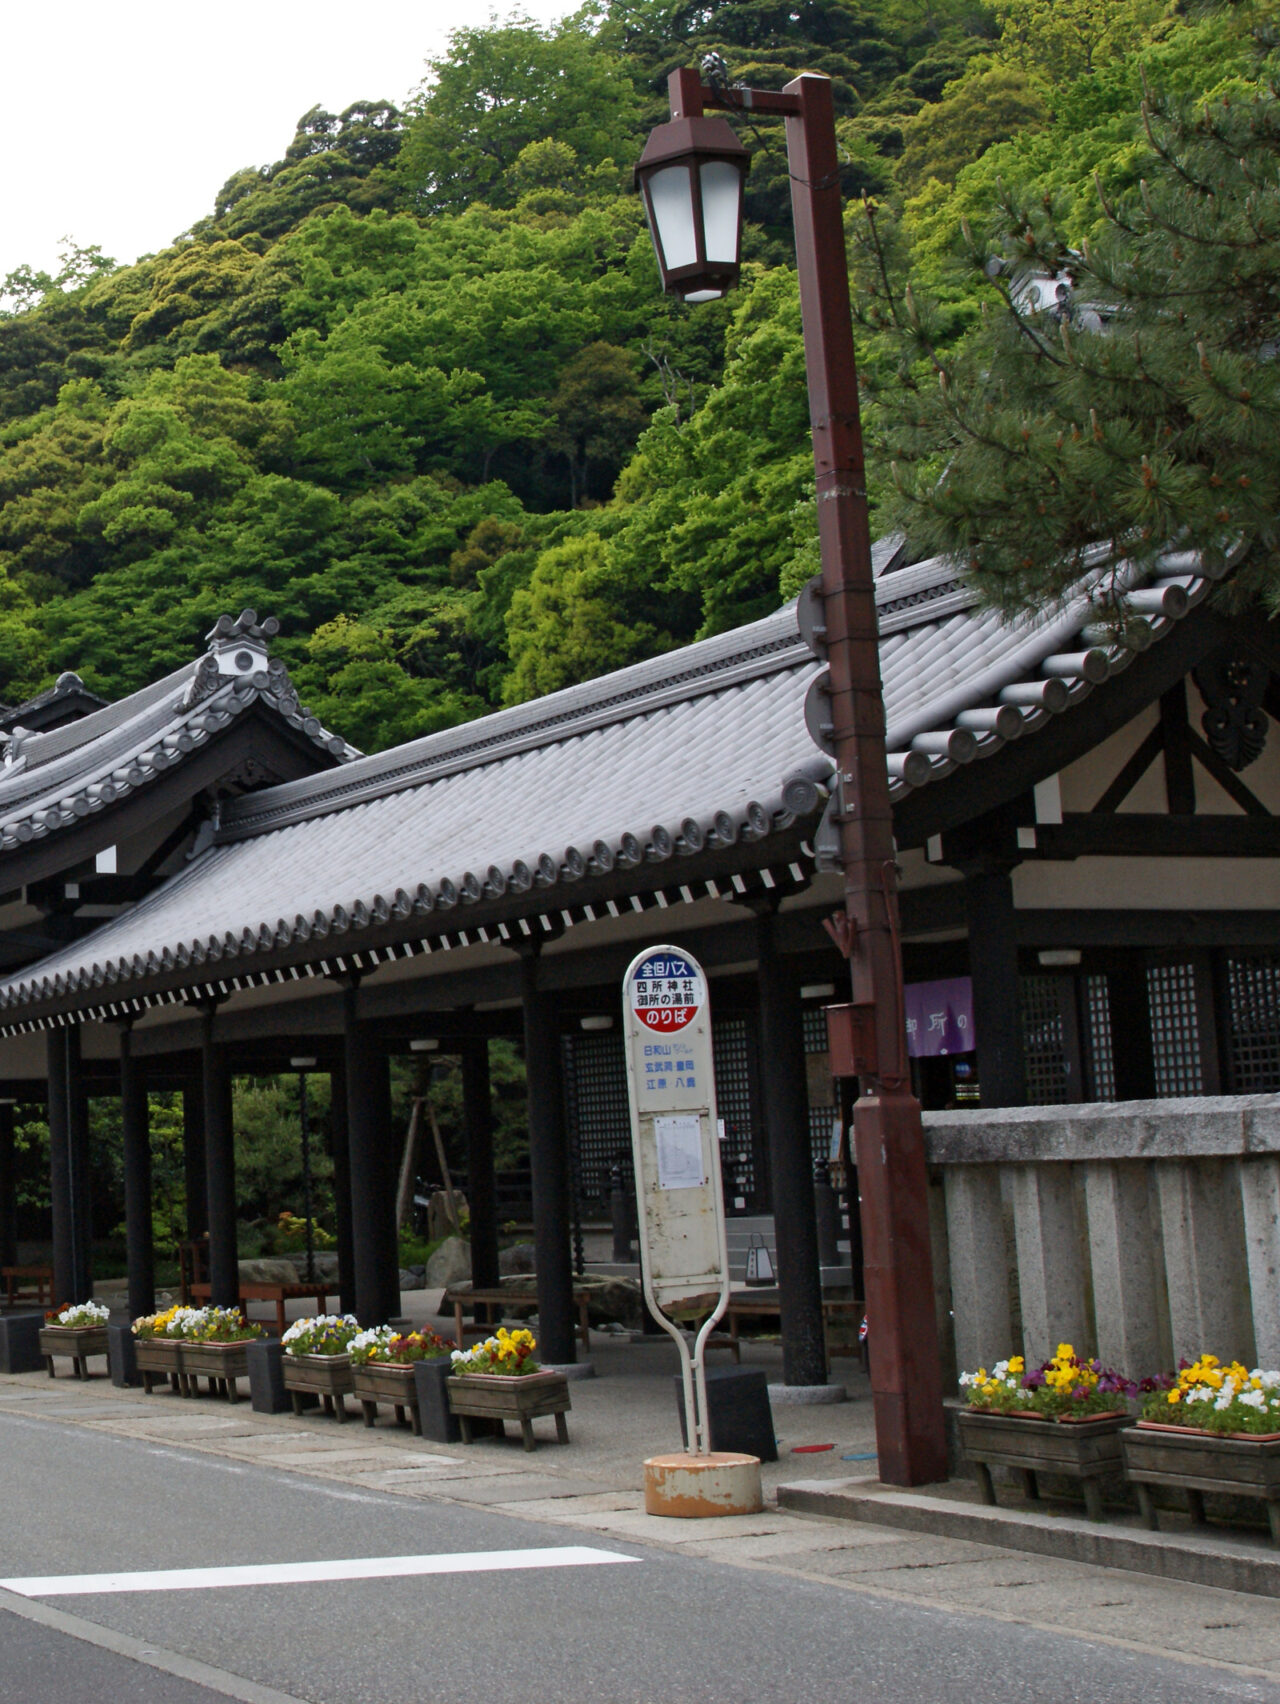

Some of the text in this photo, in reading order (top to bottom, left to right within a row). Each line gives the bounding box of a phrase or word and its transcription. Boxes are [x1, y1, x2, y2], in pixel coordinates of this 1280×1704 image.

[641, 961, 688, 977] 全但バス
[637, 979, 694, 993] 四所神社
[637, 992, 695, 1007] 御所の湯前
[646, 1008, 688, 1025] のりば
[644, 1044, 672, 1057] 日和山
